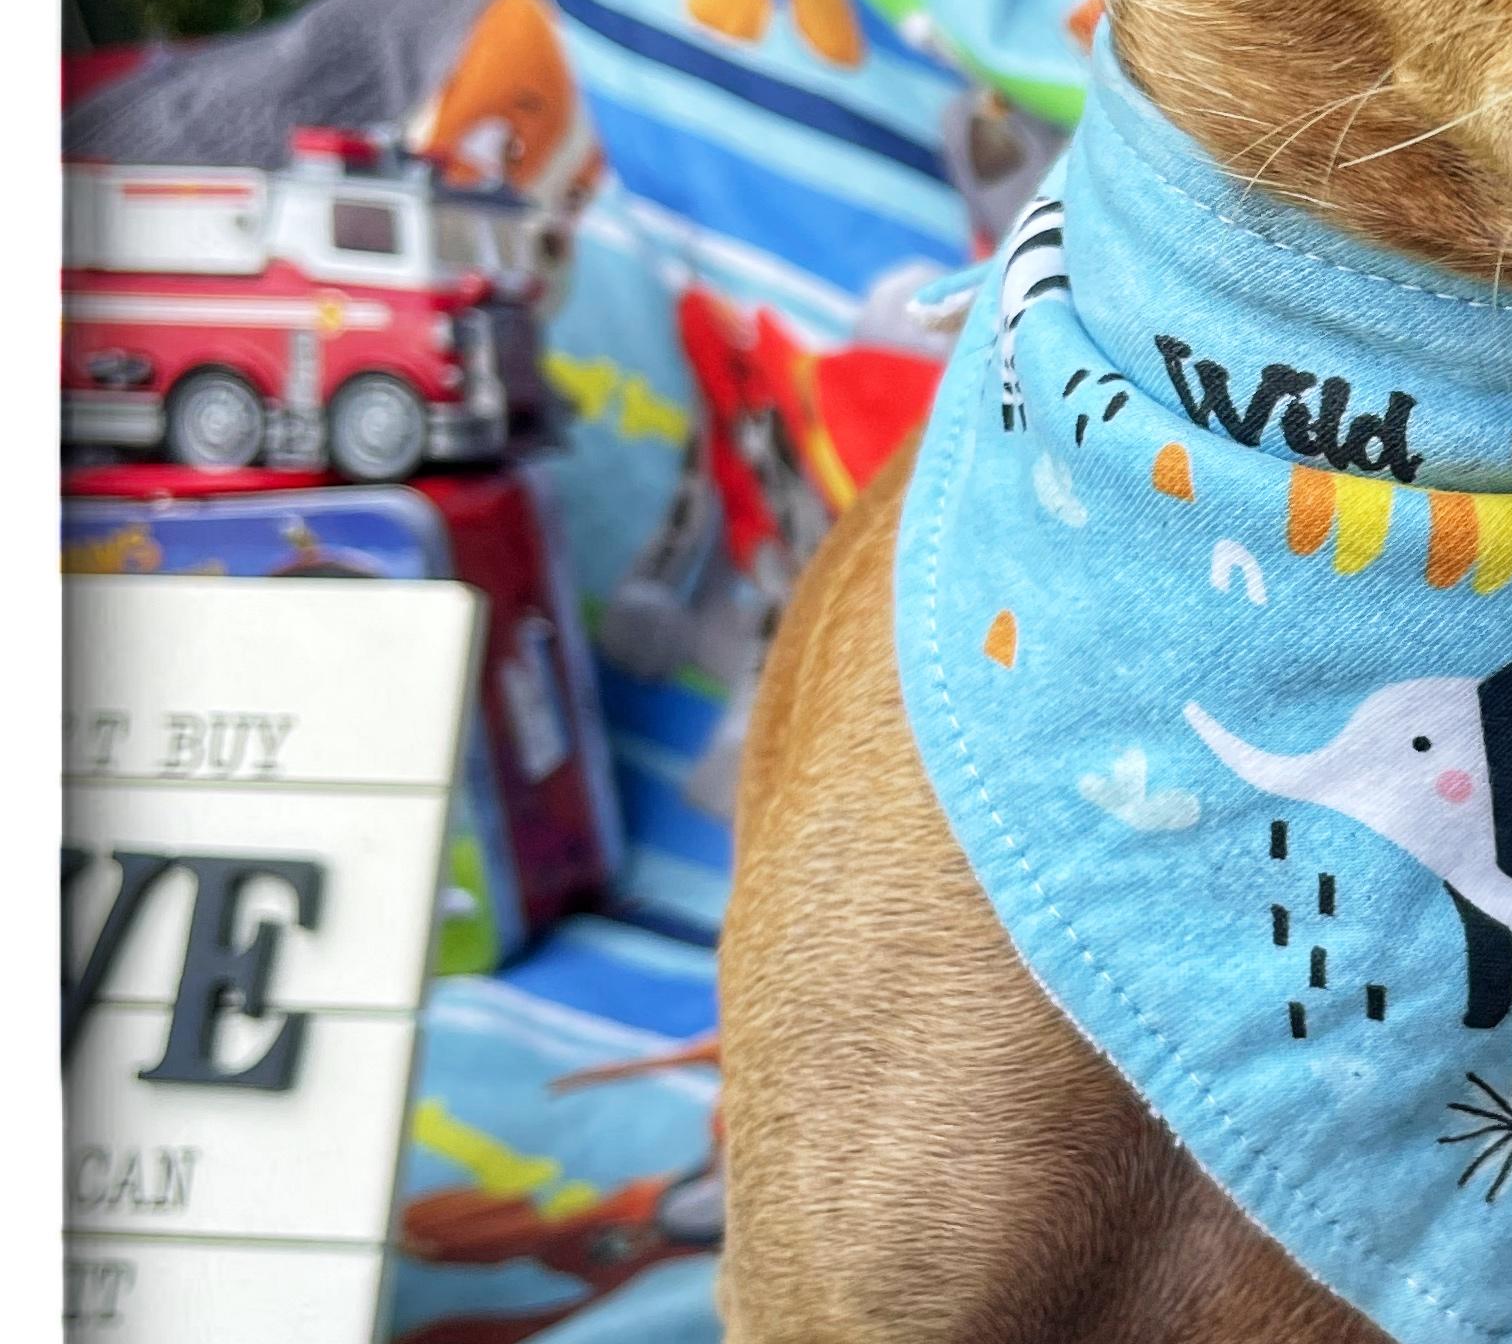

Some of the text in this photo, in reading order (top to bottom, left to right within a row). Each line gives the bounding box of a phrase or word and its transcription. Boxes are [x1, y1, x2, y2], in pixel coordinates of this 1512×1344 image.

[1154, 334, 1424, 484] Wild
[156, 711, 300, 778] BUY
[67, 1144, 202, 1214] CAN
